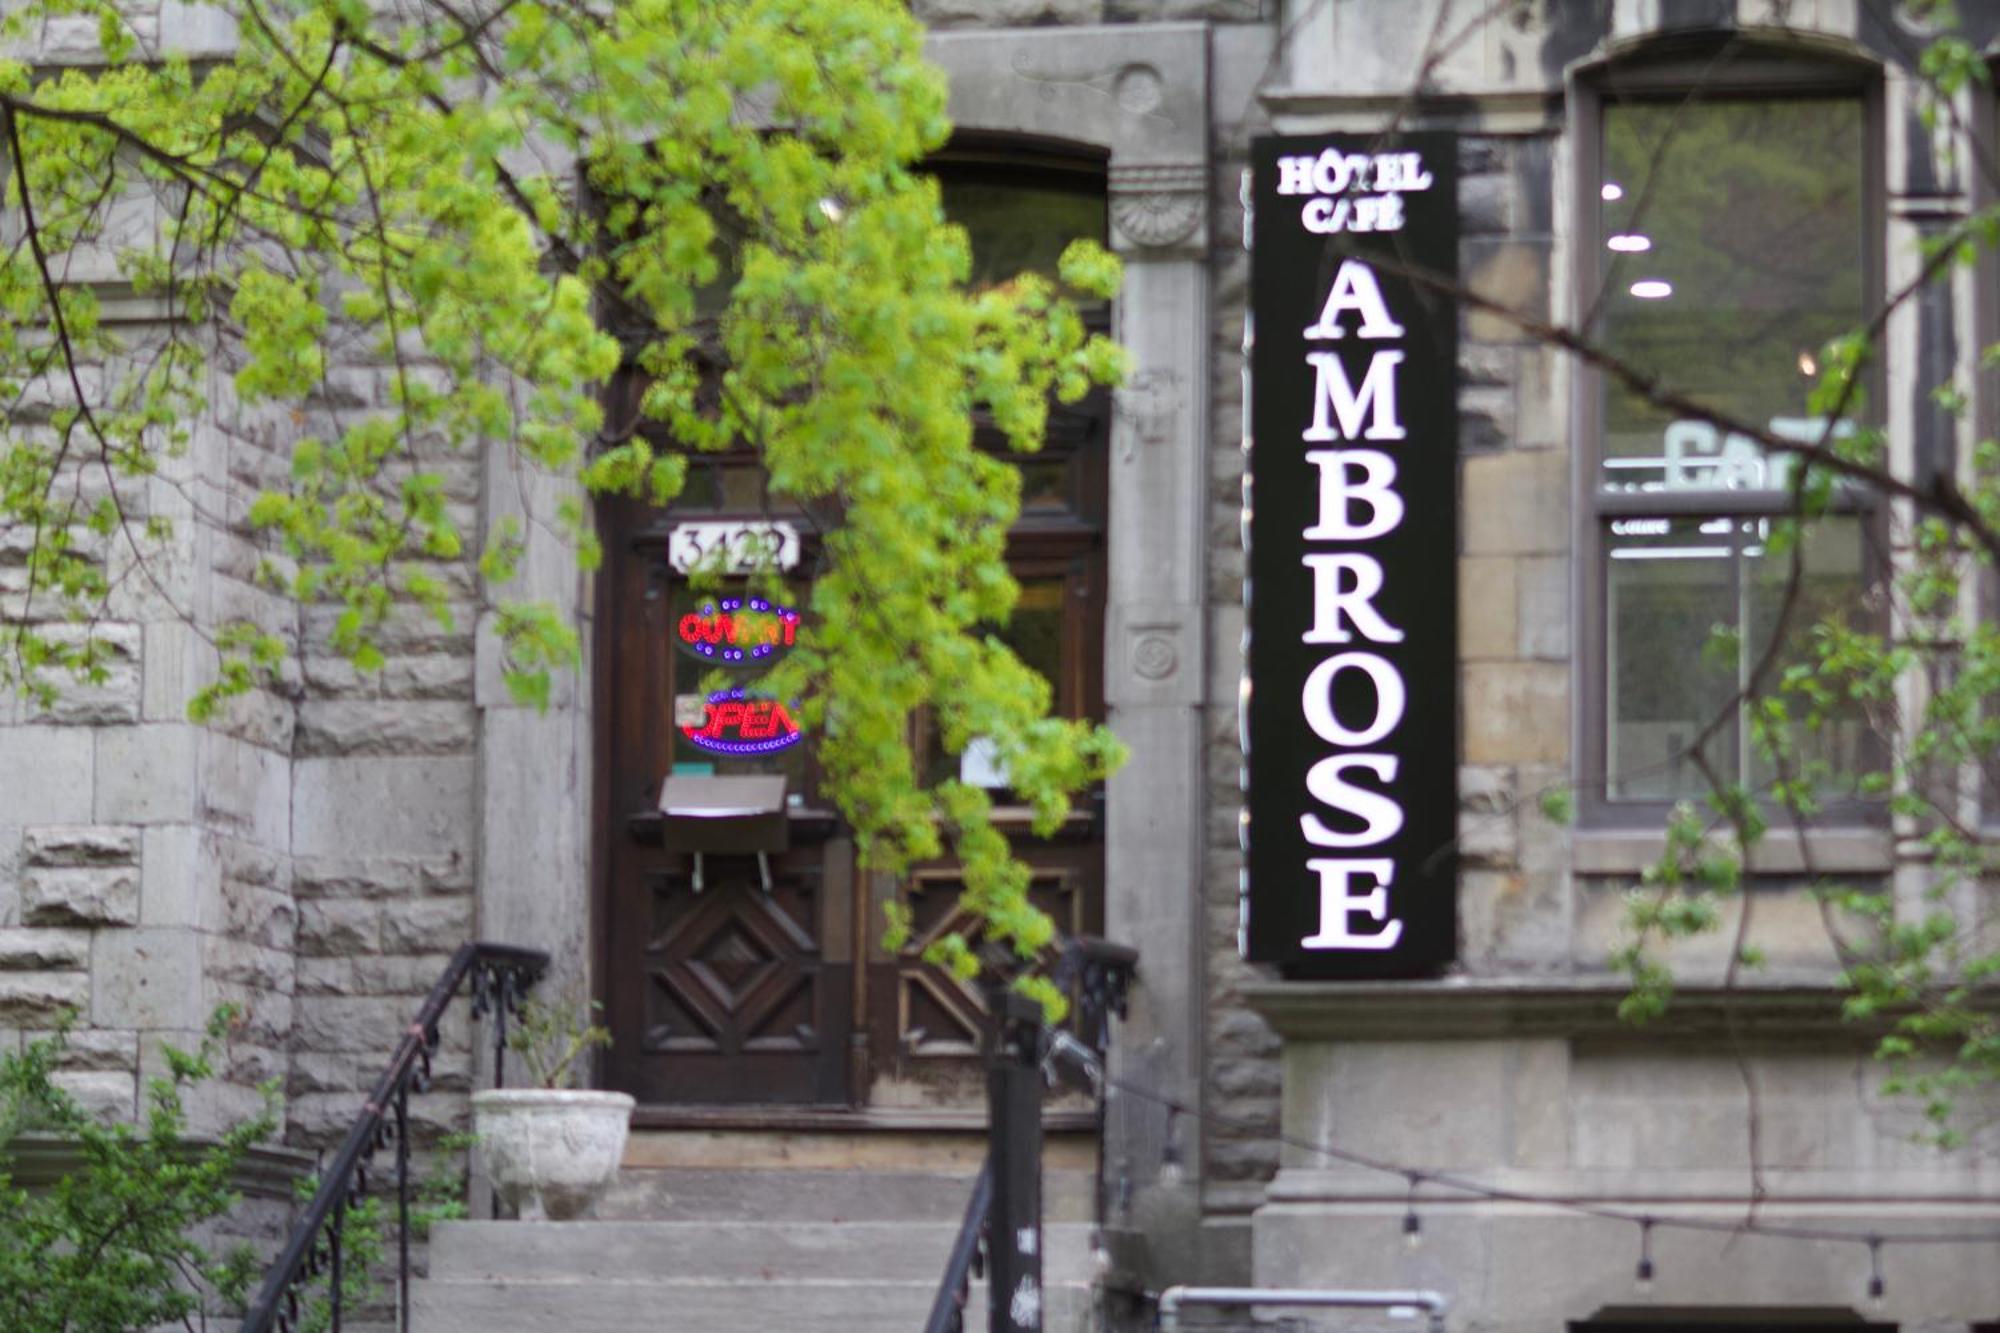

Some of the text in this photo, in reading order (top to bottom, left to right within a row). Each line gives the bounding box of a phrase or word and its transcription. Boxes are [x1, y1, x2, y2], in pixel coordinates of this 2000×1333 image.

[1276, 147, 1433, 195] HÔTEL
[1301, 259, 1405, 949] AMBROSE
[682, 700, 801, 738] OPEN
